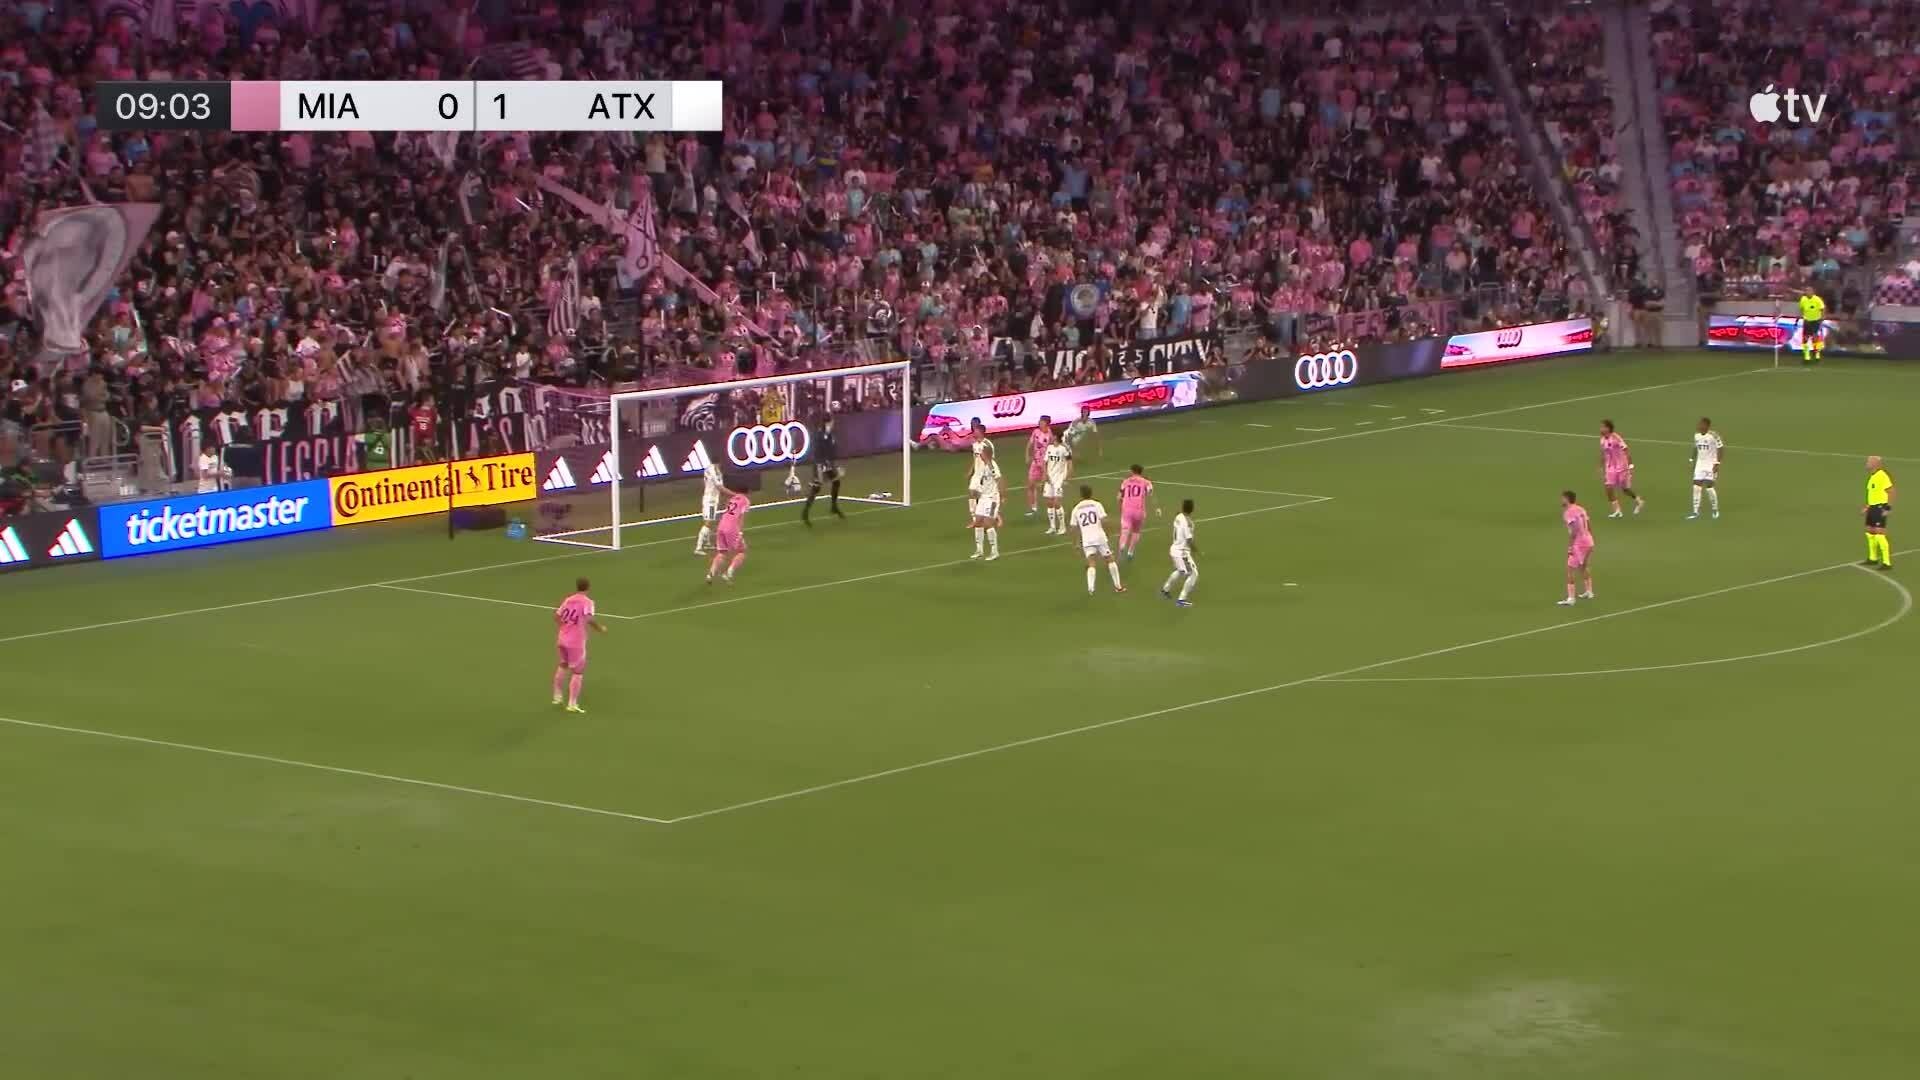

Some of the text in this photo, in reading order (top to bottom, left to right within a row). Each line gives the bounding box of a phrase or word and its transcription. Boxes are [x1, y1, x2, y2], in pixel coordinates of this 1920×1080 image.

[336, 462, 533, 518] Continental Tire
[1127, 485, 1141, 498] 10
[126, 495, 309, 546] ticketmaster
[1079, 511, 1098, 527] 20
[560, 607, 580, 625] 24
